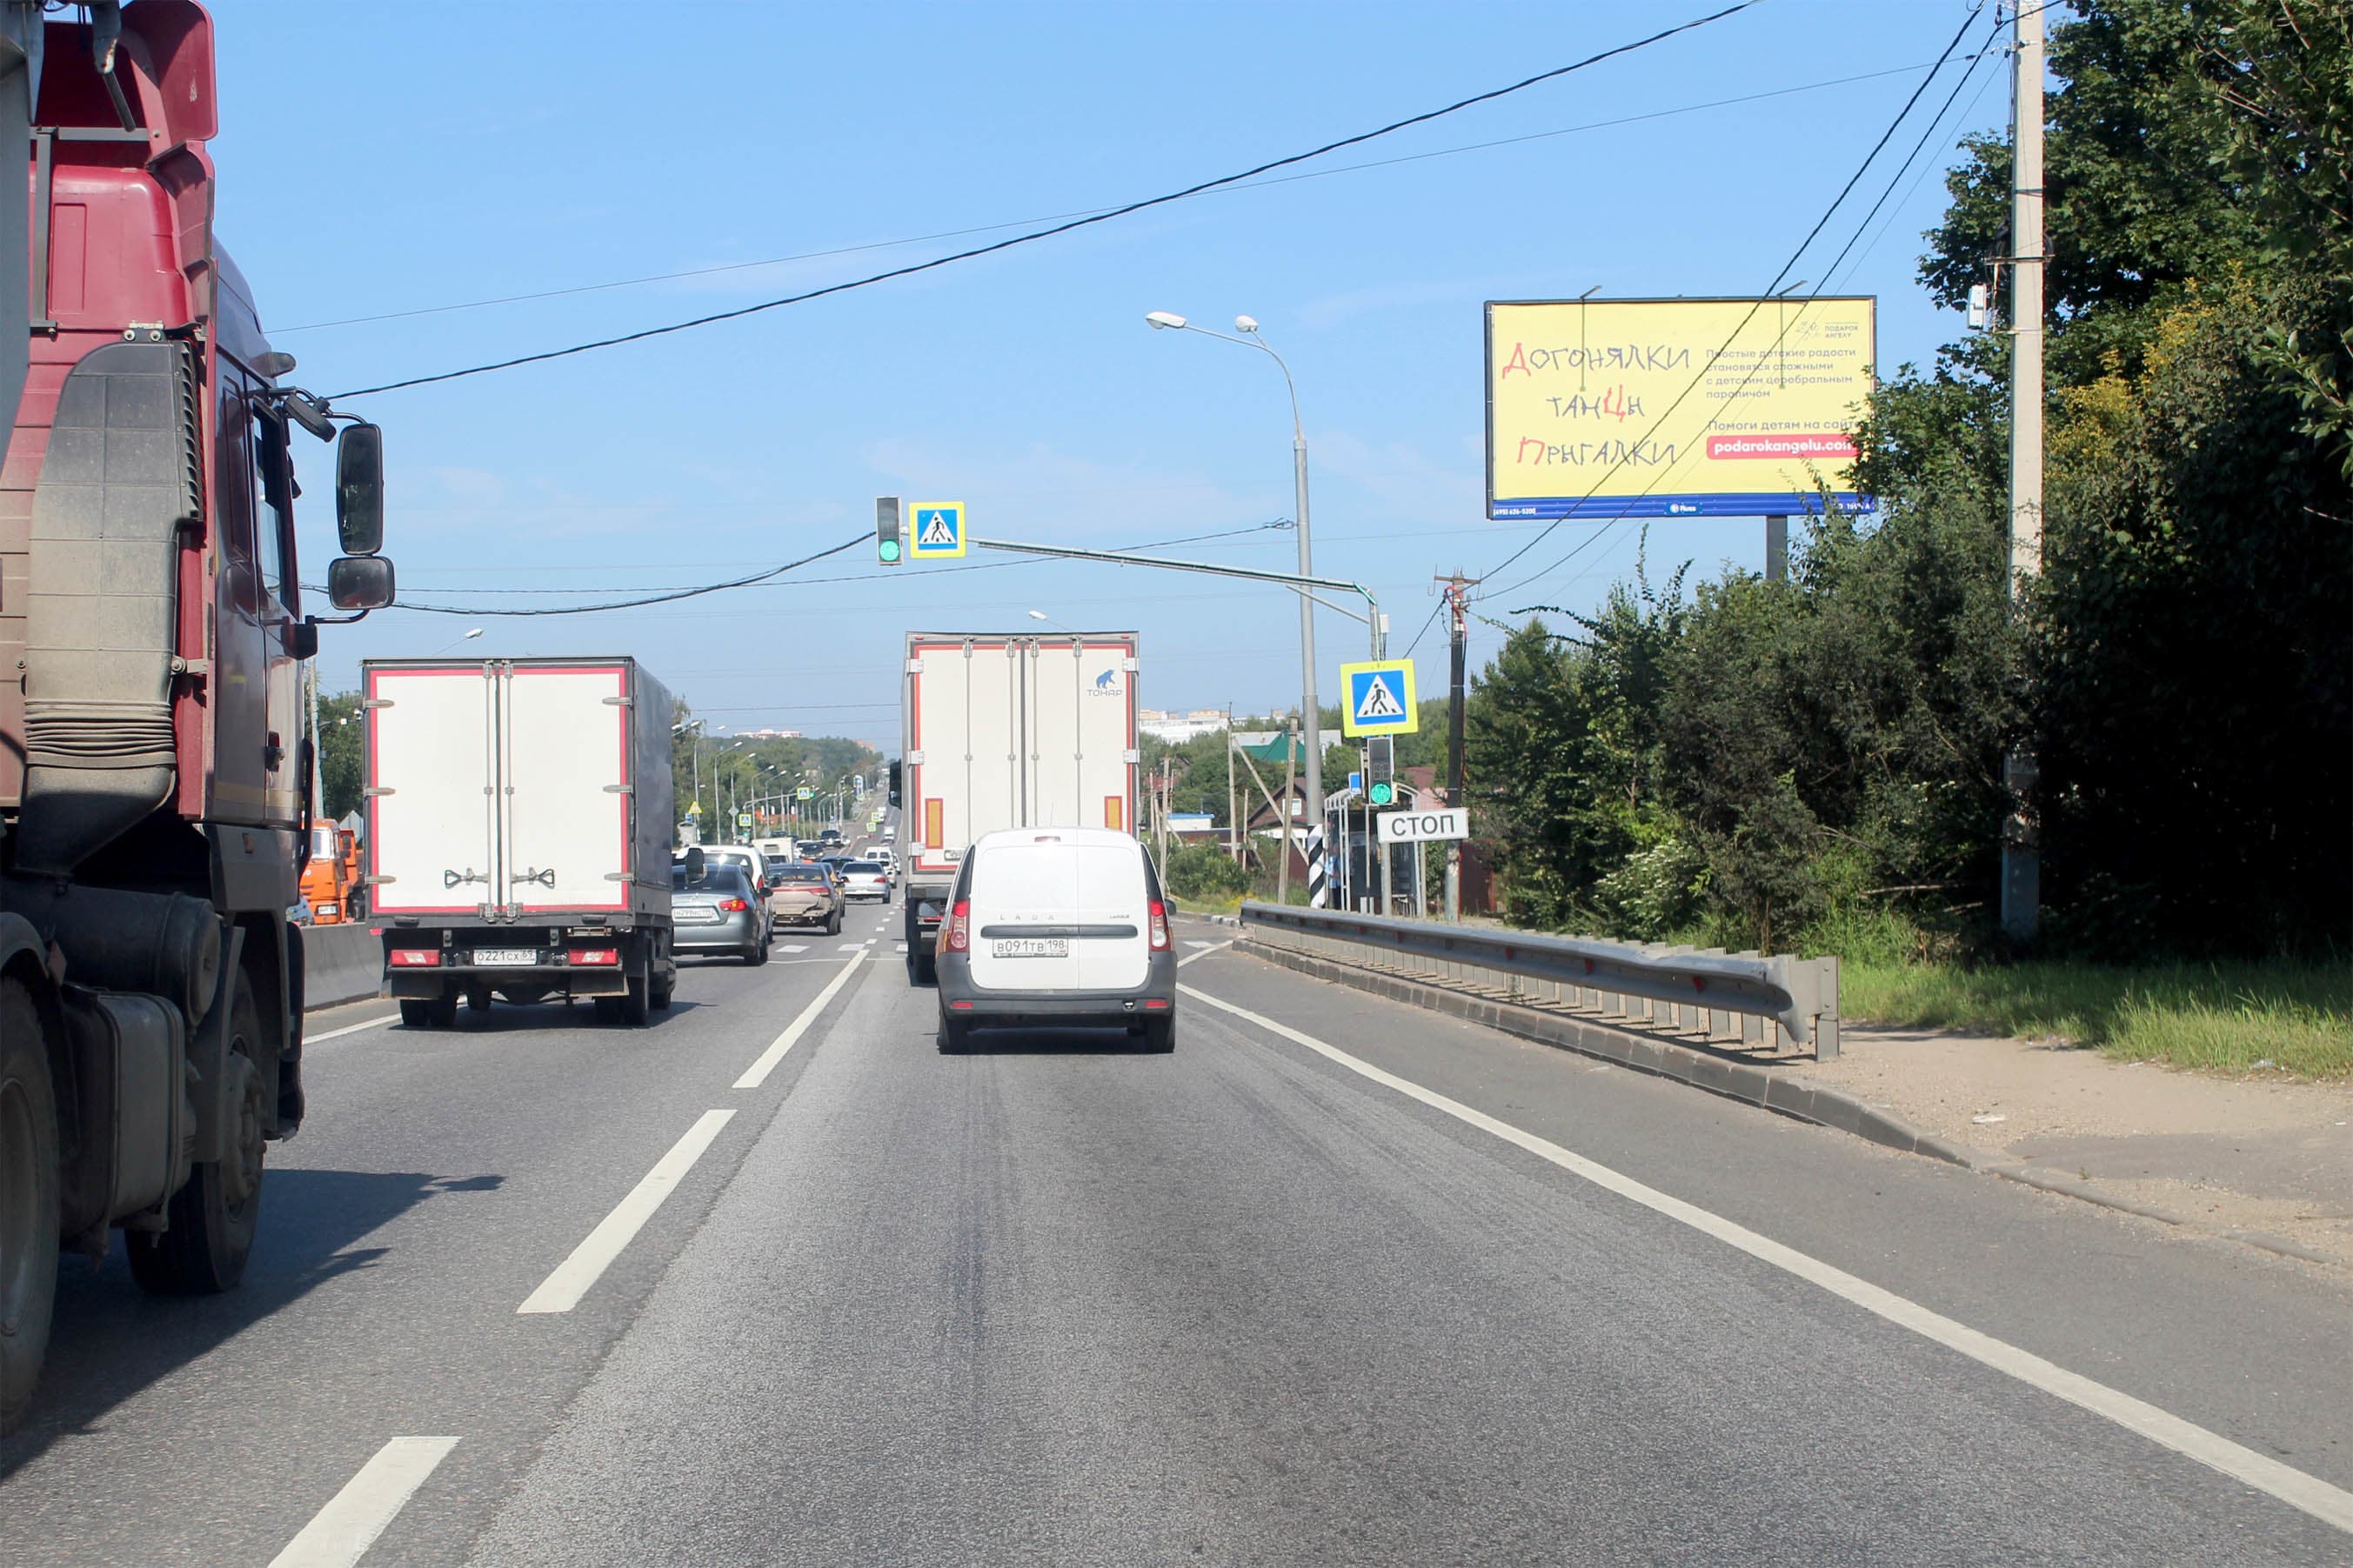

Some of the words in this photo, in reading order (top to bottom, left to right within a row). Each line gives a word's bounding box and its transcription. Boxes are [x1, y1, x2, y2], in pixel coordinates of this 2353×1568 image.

[1706, 348, 1756, 358] Простые
[1759, 349, 1806, 357] детские
[1808, 348, 1856, 358] радости
[1707, 364, 1770, 372] становятся
[1773, 362, 1834, 370] сложными
[1715, 377, 1763, 385] детским
[1766, 375, 1853, 386] церебральным
[1706, 390, 1771, 400] параличом
[1709, 420, 1757, 430] Помоги
[1761, 420, 1801, 430] детям
[1392, 815, 1454, 836] СТОП
